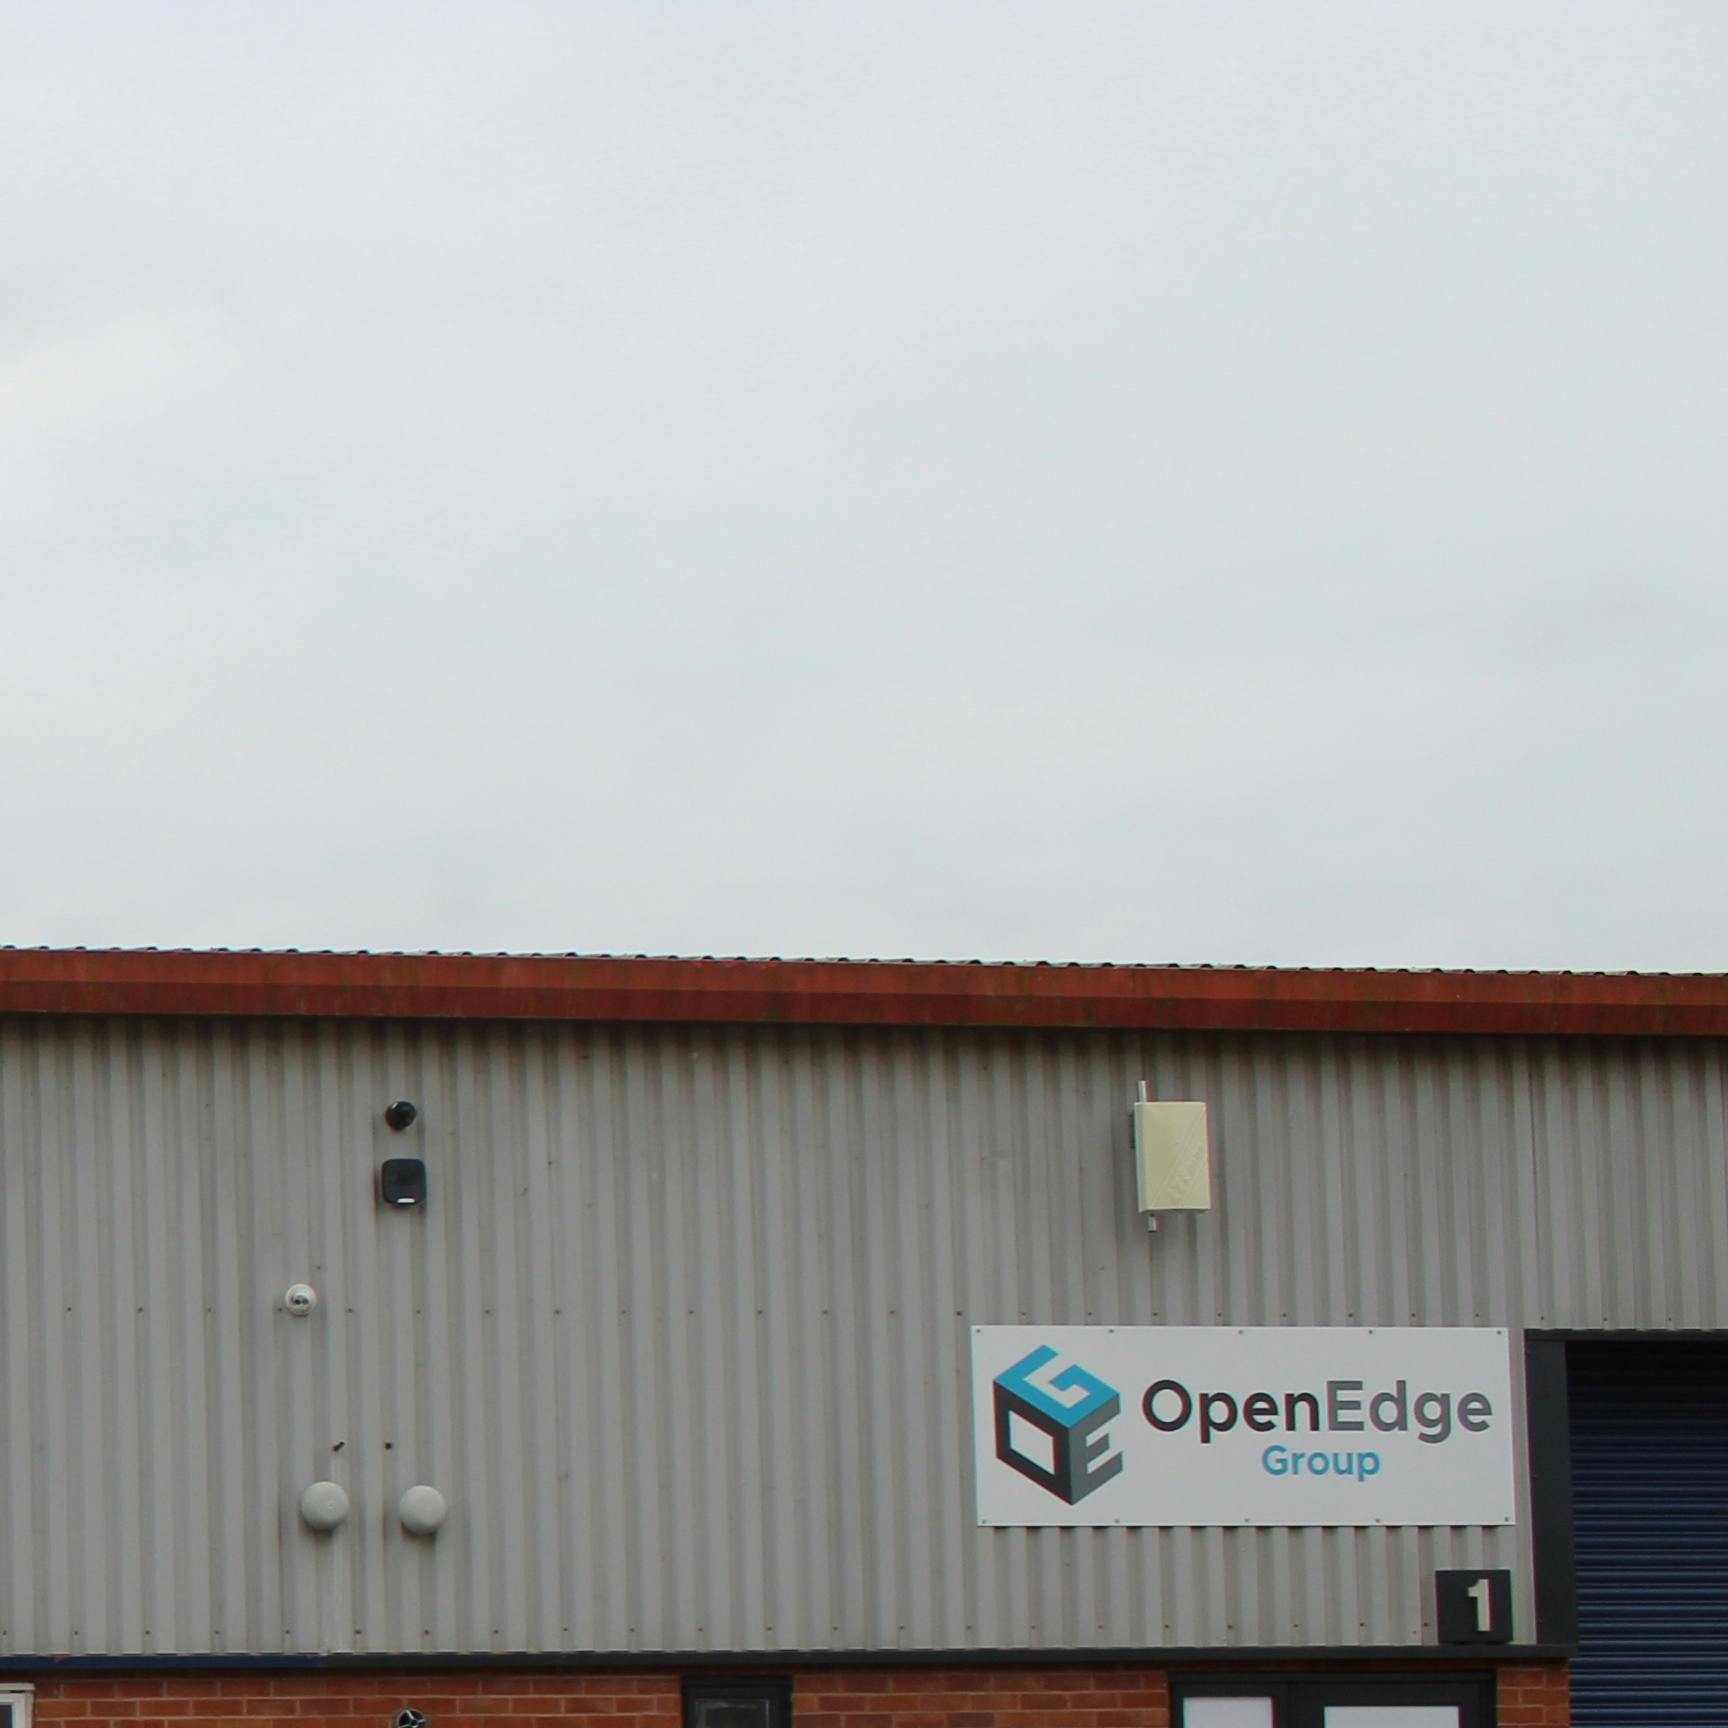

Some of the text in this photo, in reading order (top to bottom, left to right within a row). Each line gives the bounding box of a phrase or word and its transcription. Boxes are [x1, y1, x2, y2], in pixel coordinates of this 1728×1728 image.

[1142, 1379, 1493, 1444] OpenEdge
[1261, 1444, 1381, 1482] Group
[1466, 1578, 1493, 1632] 1
